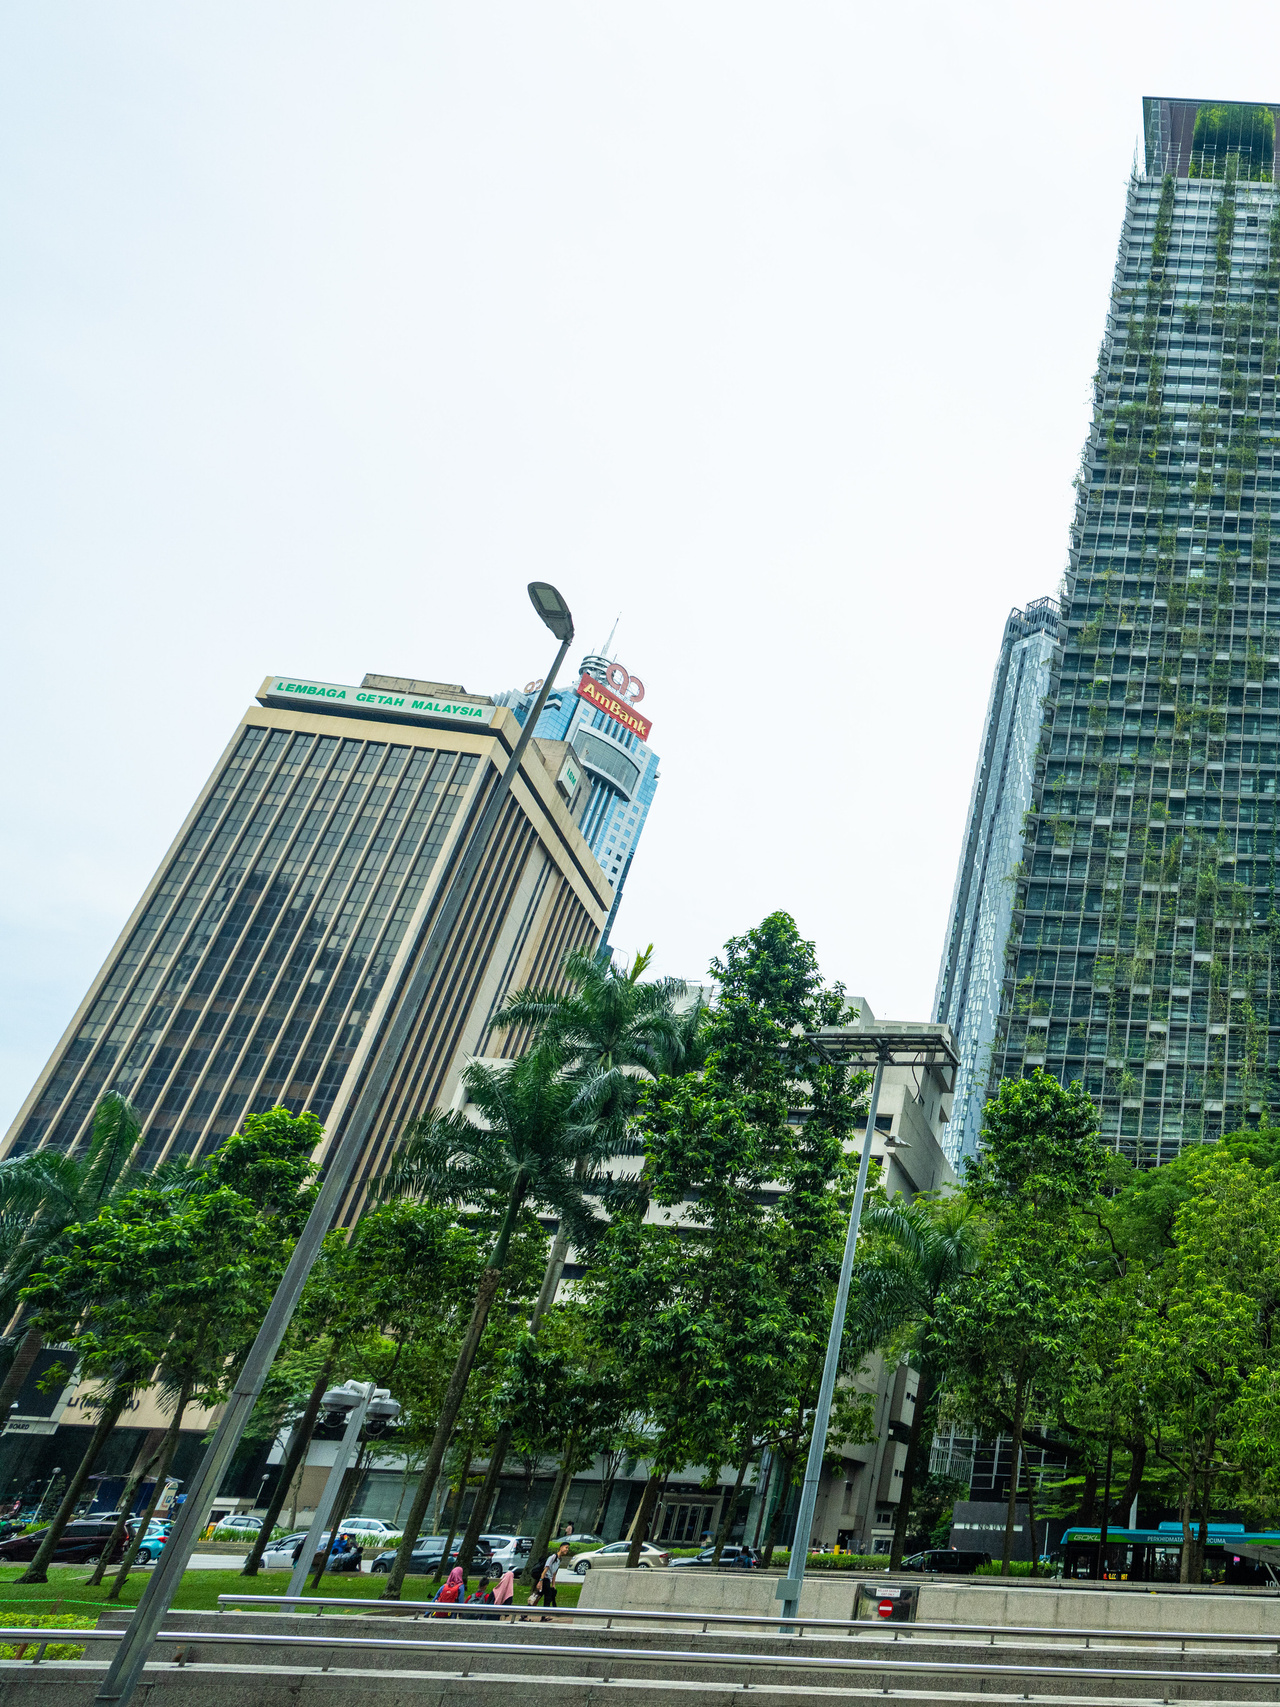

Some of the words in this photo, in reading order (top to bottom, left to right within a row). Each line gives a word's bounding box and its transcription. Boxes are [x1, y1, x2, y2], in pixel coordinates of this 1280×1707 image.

[276, 682, 347, 699] LEMBAGA
[356, 693, 405, 707] GETAH
[411, 700, 483, 717] MALAYSIA
[583, 683, 647, 735] AmBank
